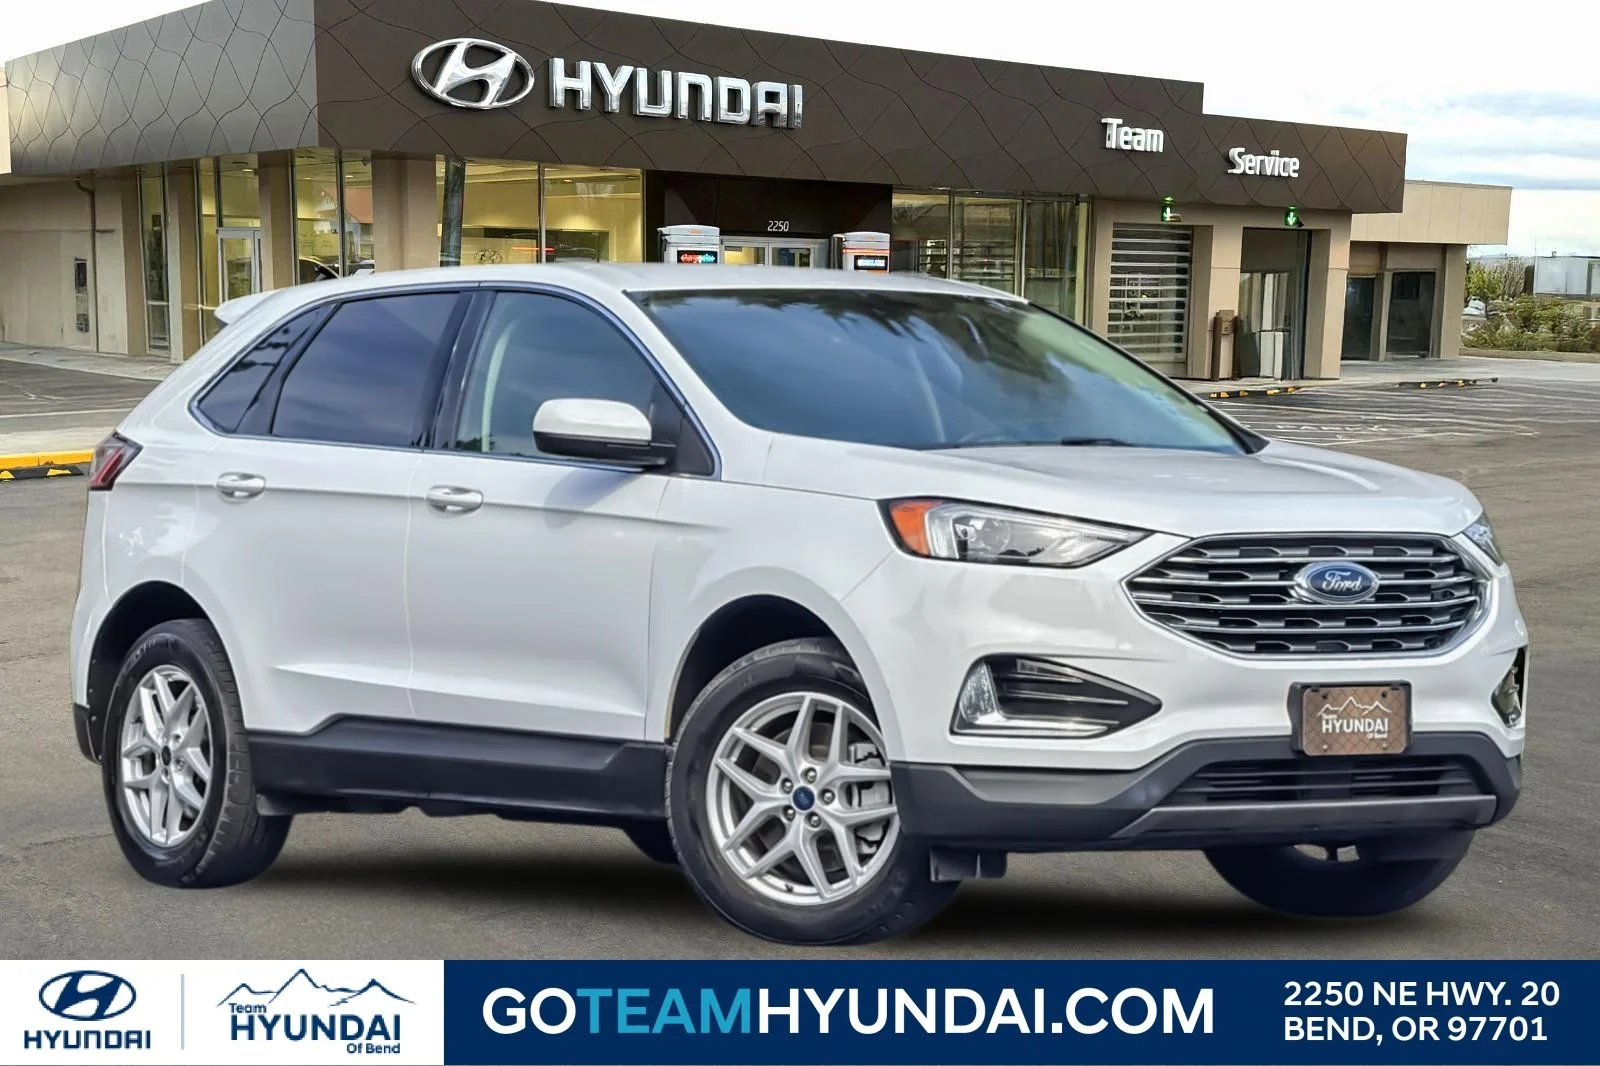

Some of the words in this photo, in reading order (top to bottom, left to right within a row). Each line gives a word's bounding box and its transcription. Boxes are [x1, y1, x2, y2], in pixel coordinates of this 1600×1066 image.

[549, 57, 803, 129] HYUNDAI
[1101, 117, 1164, 153] Team
[1227, 147, 1300, 178] Service
[767, 220, 790, 232] 2250
[1322, 571, 1362, 592] Ford
[1322, 718, 1389, 733] HYUNDAI
